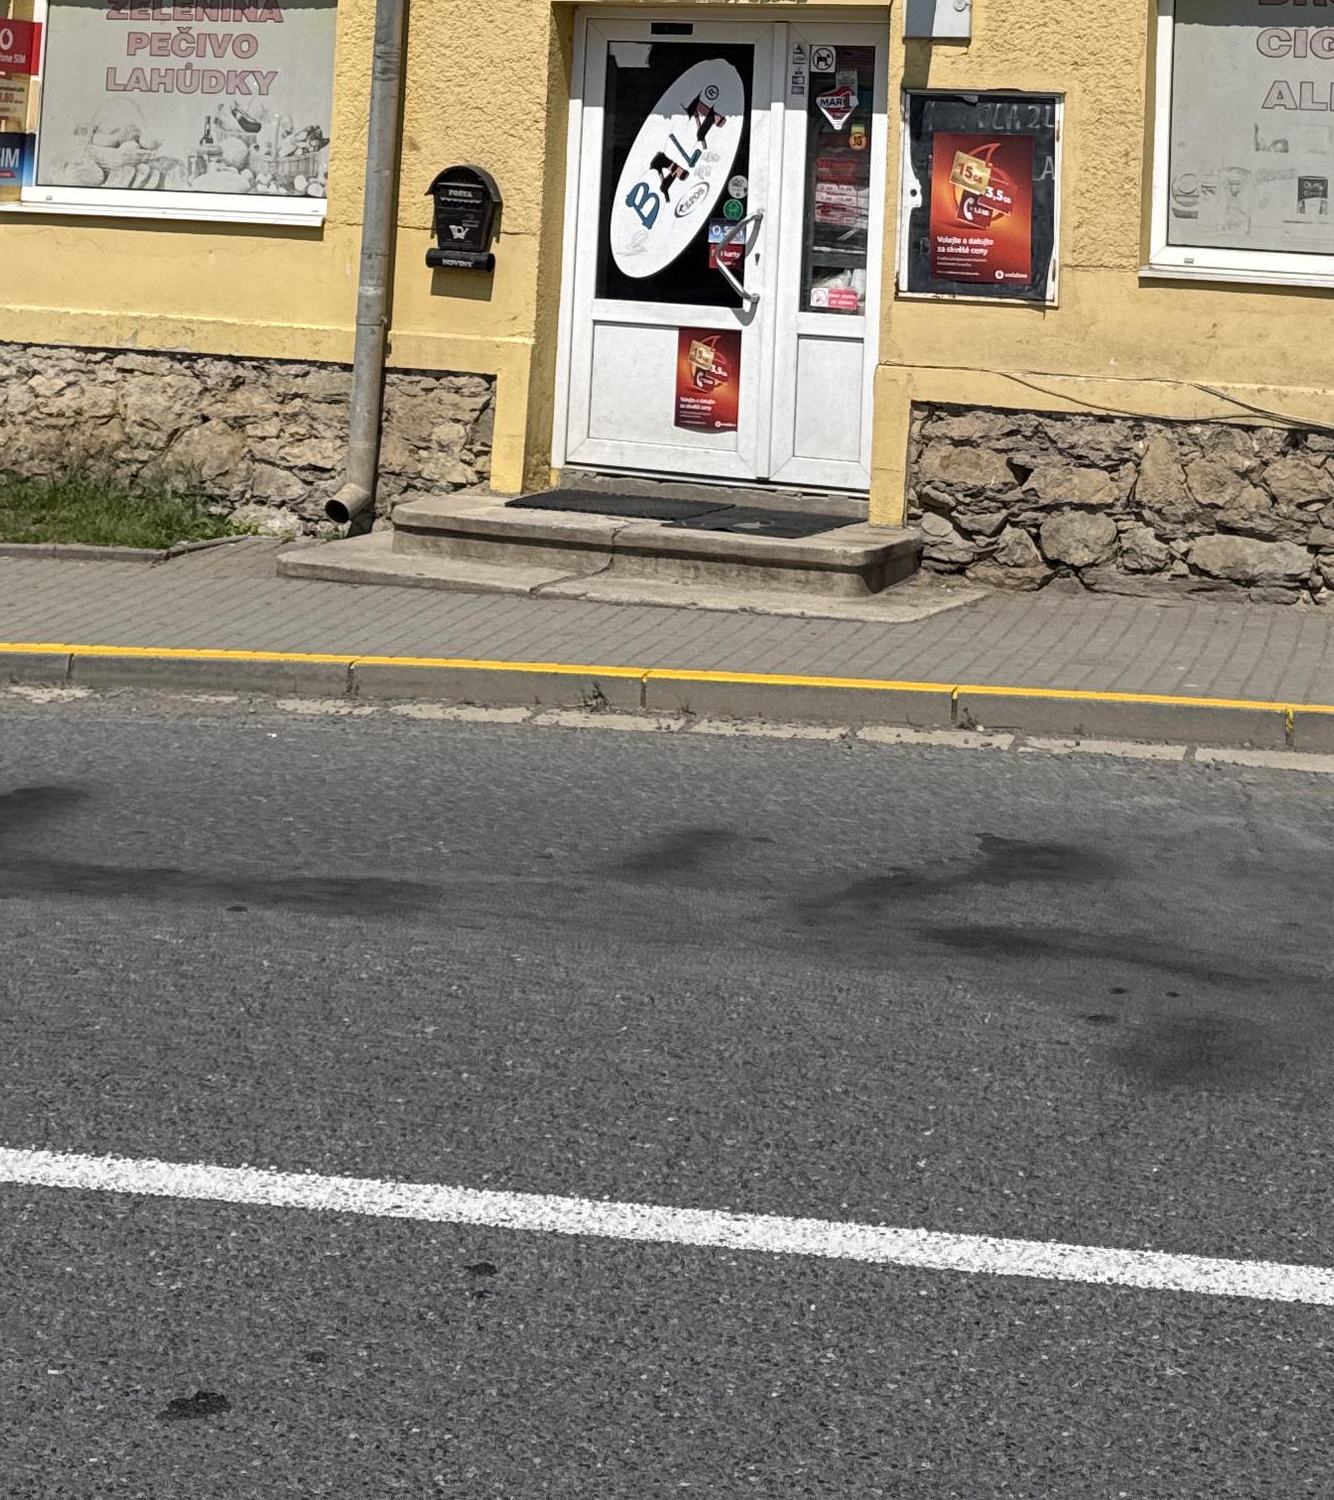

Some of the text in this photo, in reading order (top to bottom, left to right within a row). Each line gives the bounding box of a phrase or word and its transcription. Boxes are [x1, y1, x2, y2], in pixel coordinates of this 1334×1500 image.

[13, 53, 26, 64] SIM
[126, 26, 259, 59] PEČIVO
[105, 62, 279, 95] LAHŮDKY
[625, 92, 727, 230] BALA
